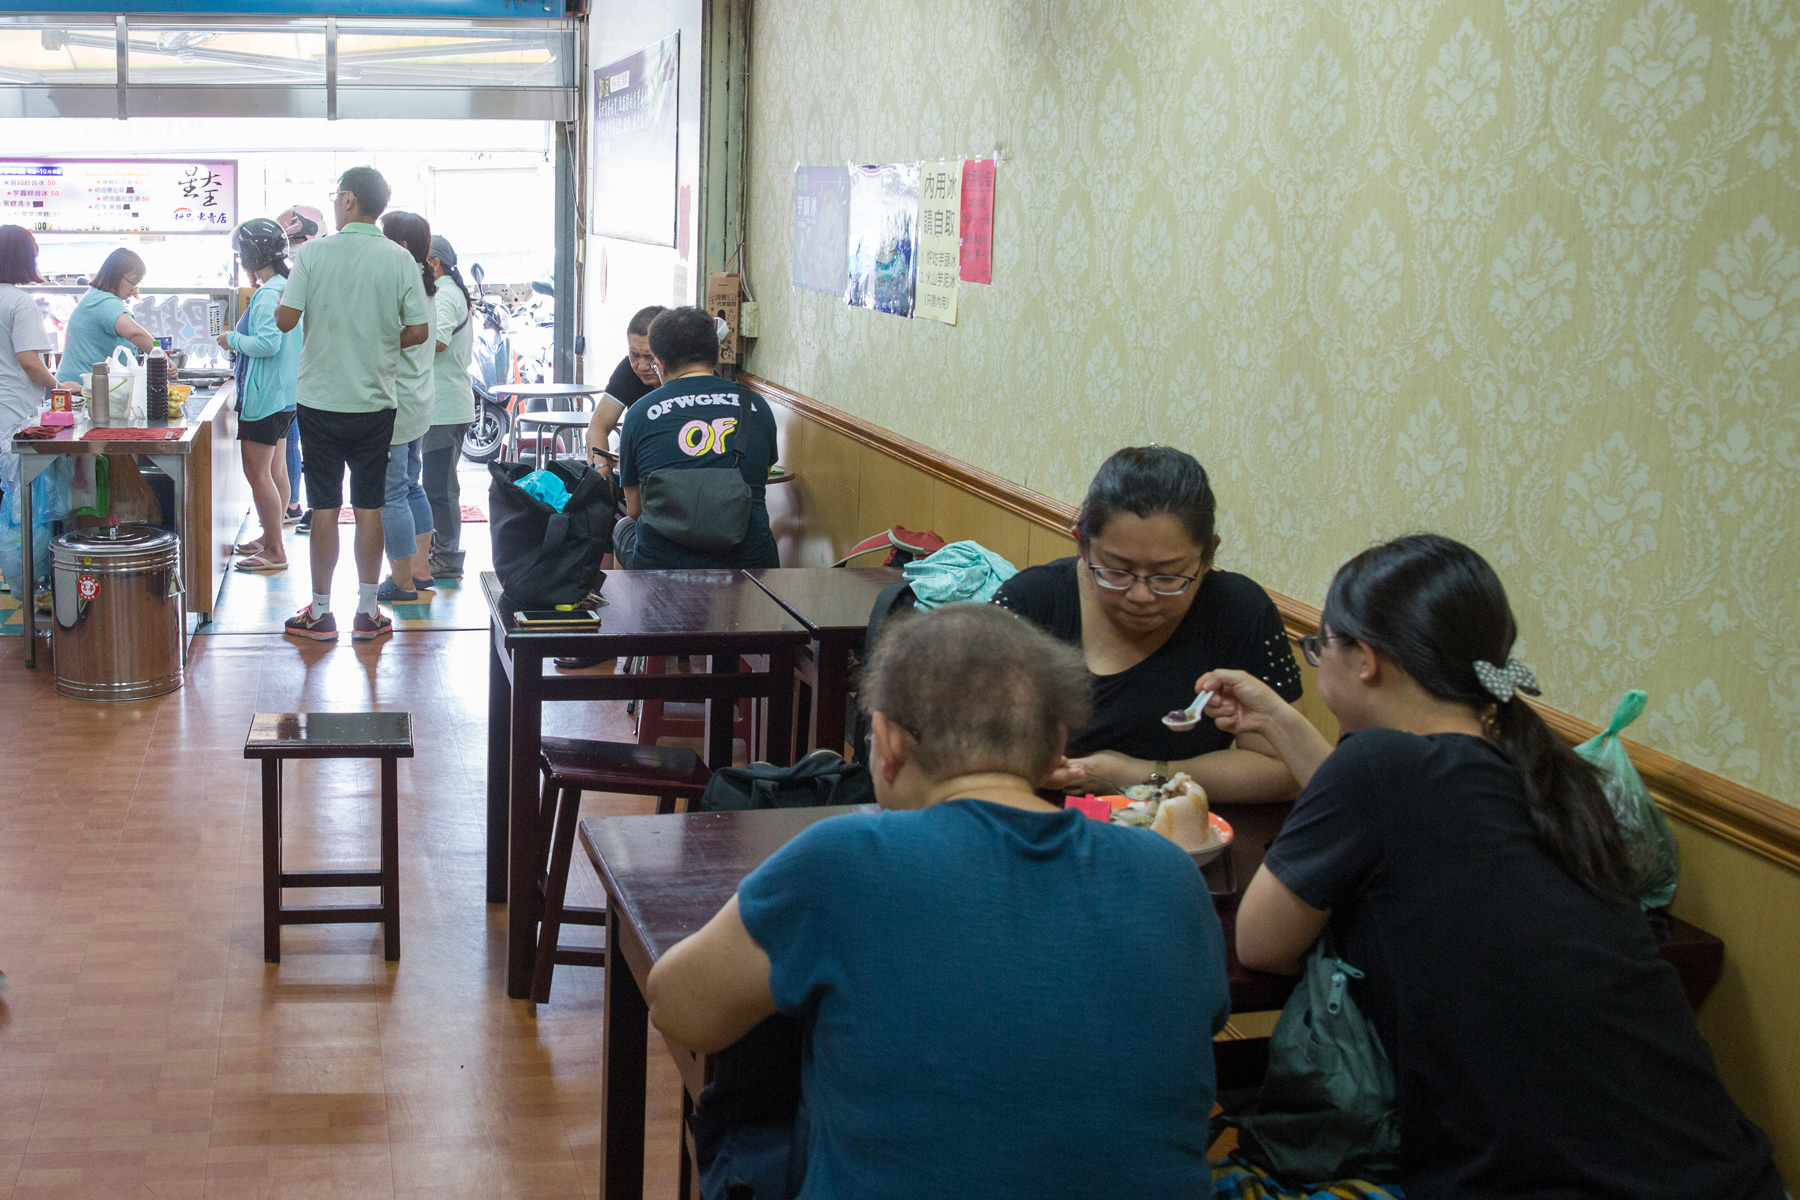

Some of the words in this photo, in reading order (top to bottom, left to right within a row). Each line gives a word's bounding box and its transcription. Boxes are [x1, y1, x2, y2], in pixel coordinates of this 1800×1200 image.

[924, 172, 957, 199] 內用冰
[796, 195, 817, 217] 芋頭冰
[924, 208, 956, 237] 請自取
[677, 416, 738, 457] OF
